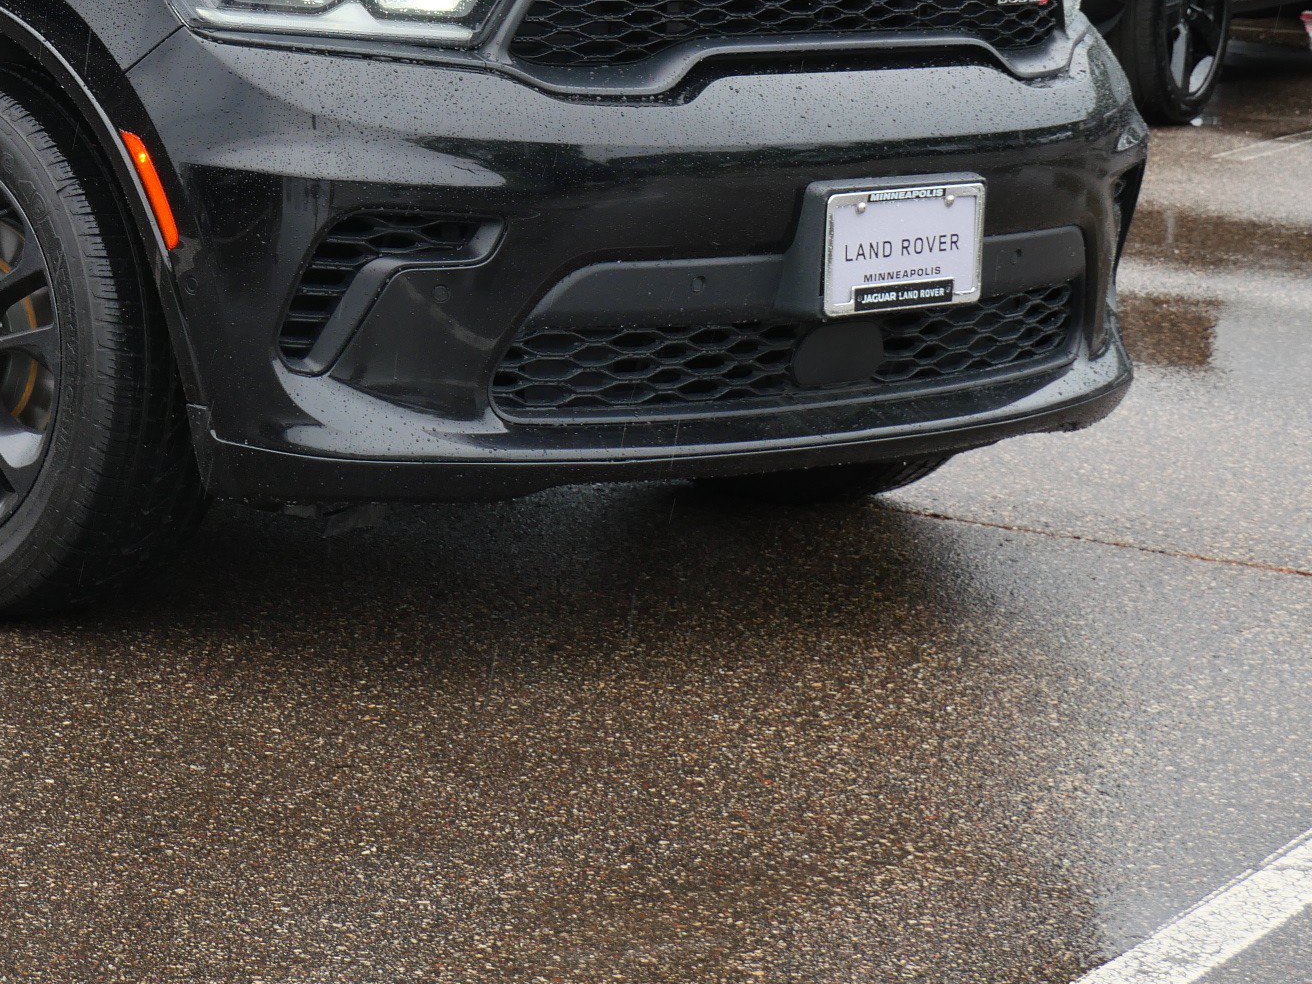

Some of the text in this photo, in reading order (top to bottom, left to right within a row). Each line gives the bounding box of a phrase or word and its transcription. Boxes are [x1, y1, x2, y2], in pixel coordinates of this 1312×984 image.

[869, 188, 944, 203] MINNEAPOLIS
[844, 233, 960, 262] LAND ROVER
[863, 266, 941, 283] MINNEAPOLIS
[861, 287, 945, 304] JAGUAR LAND ROVER
